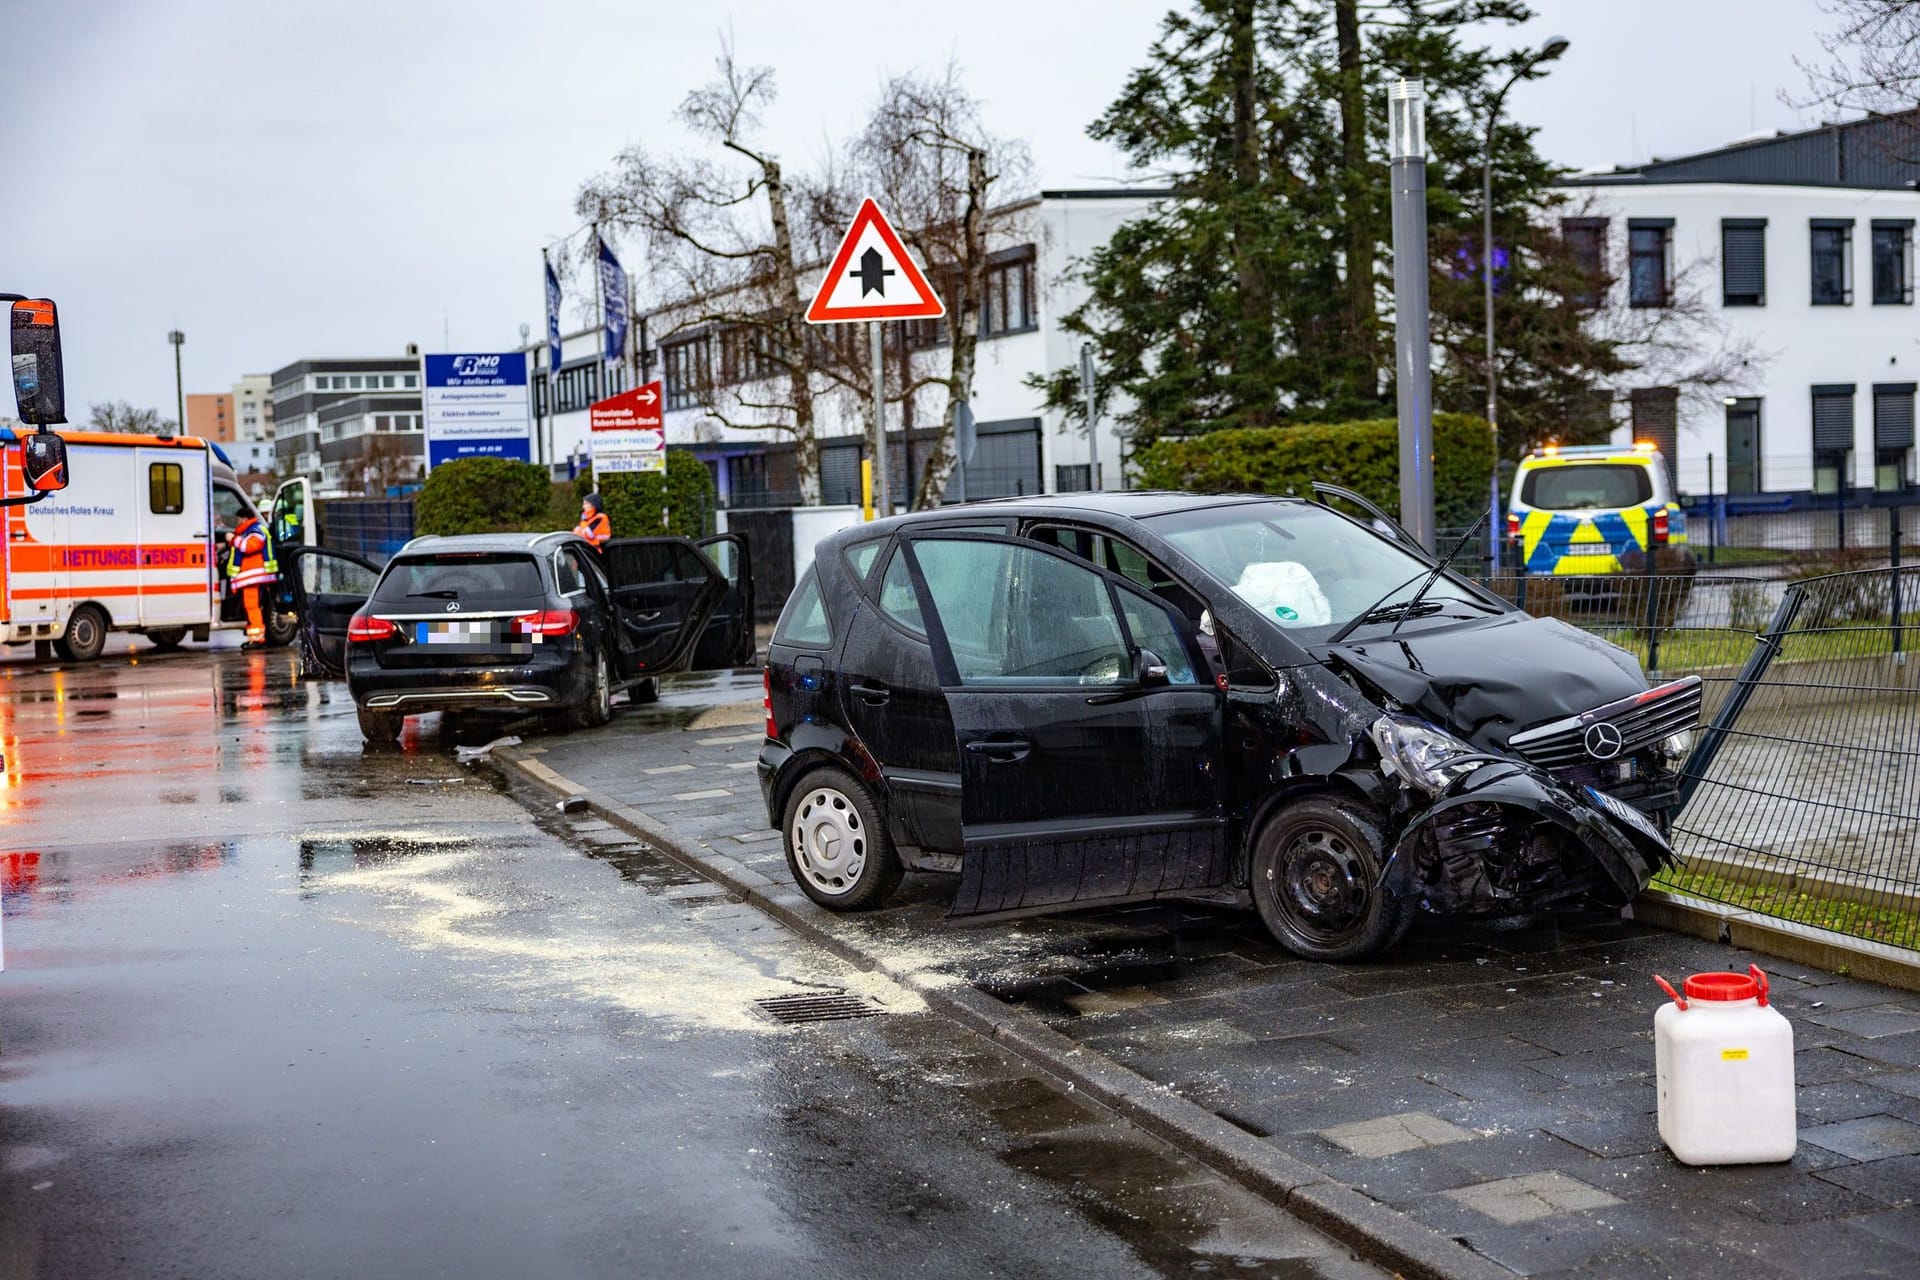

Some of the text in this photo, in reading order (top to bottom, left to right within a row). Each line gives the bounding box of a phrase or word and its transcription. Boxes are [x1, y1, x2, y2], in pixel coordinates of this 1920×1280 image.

[453, 356, 500, 375] ERMO
[463, 377, 489, 385] stellen
[593, 408, 634, 418] Dieselstraße
[593, 417, 660, 427] Robert-Bosch-Straße
[29, 505, 114, 515] Deutsches Rotes Kreuz
